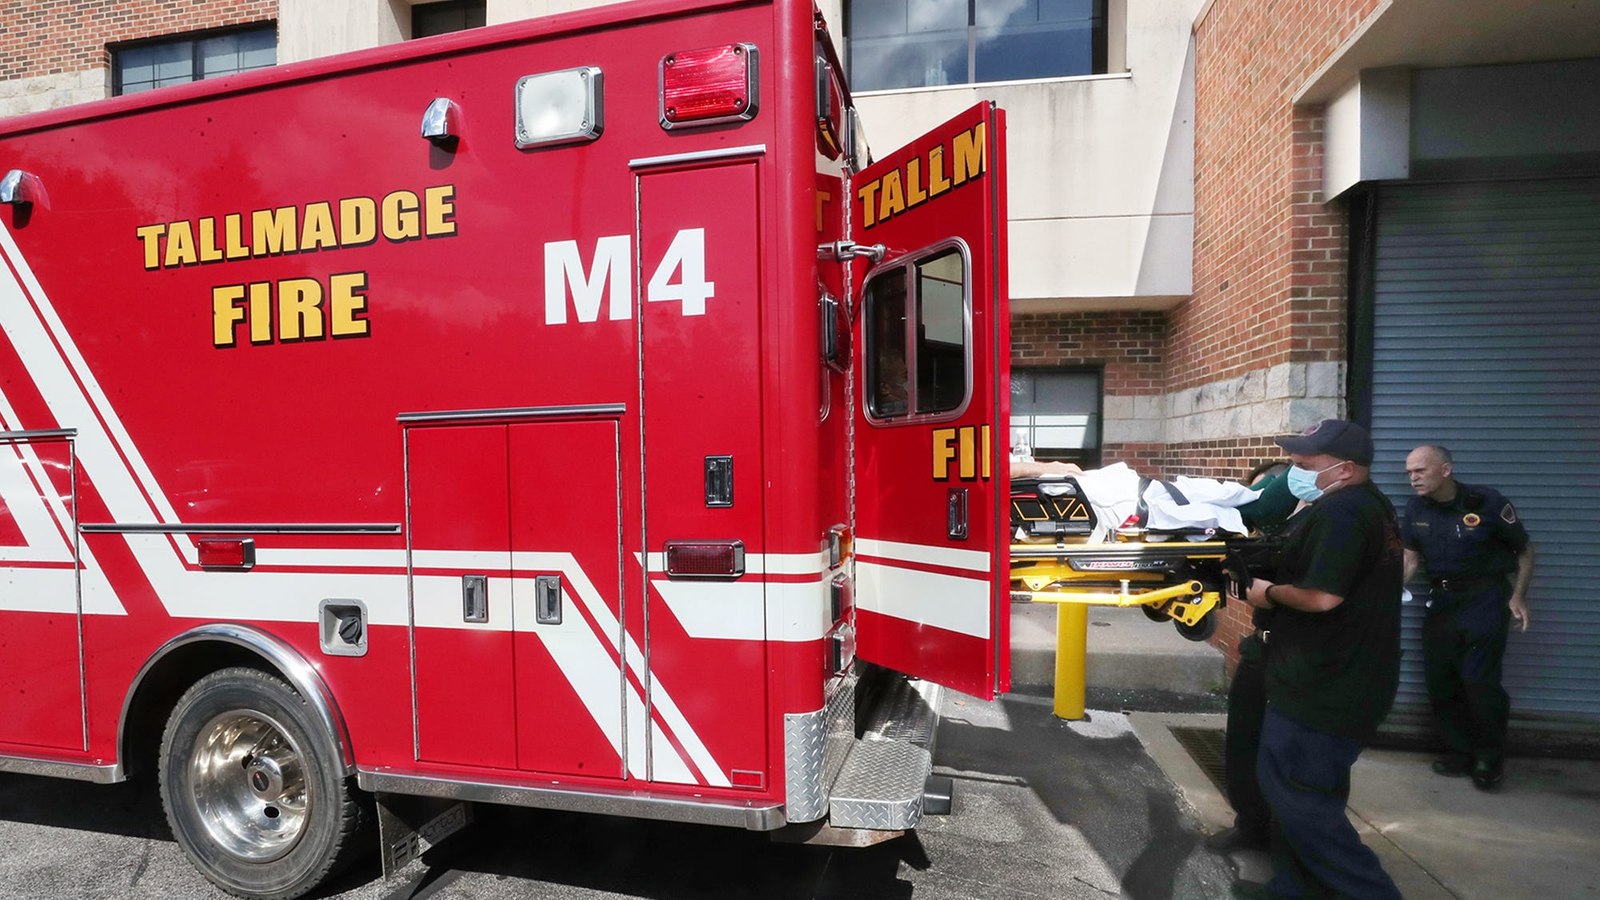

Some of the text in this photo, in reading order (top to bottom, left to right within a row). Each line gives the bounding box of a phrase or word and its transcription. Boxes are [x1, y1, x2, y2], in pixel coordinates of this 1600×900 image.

[857, 121, 986, 230] TALLM
[136, 184, 457, 270] TALLMADGE
[212, 271, 369, 348] FIRE
[543, 228, 715, 325] M4
